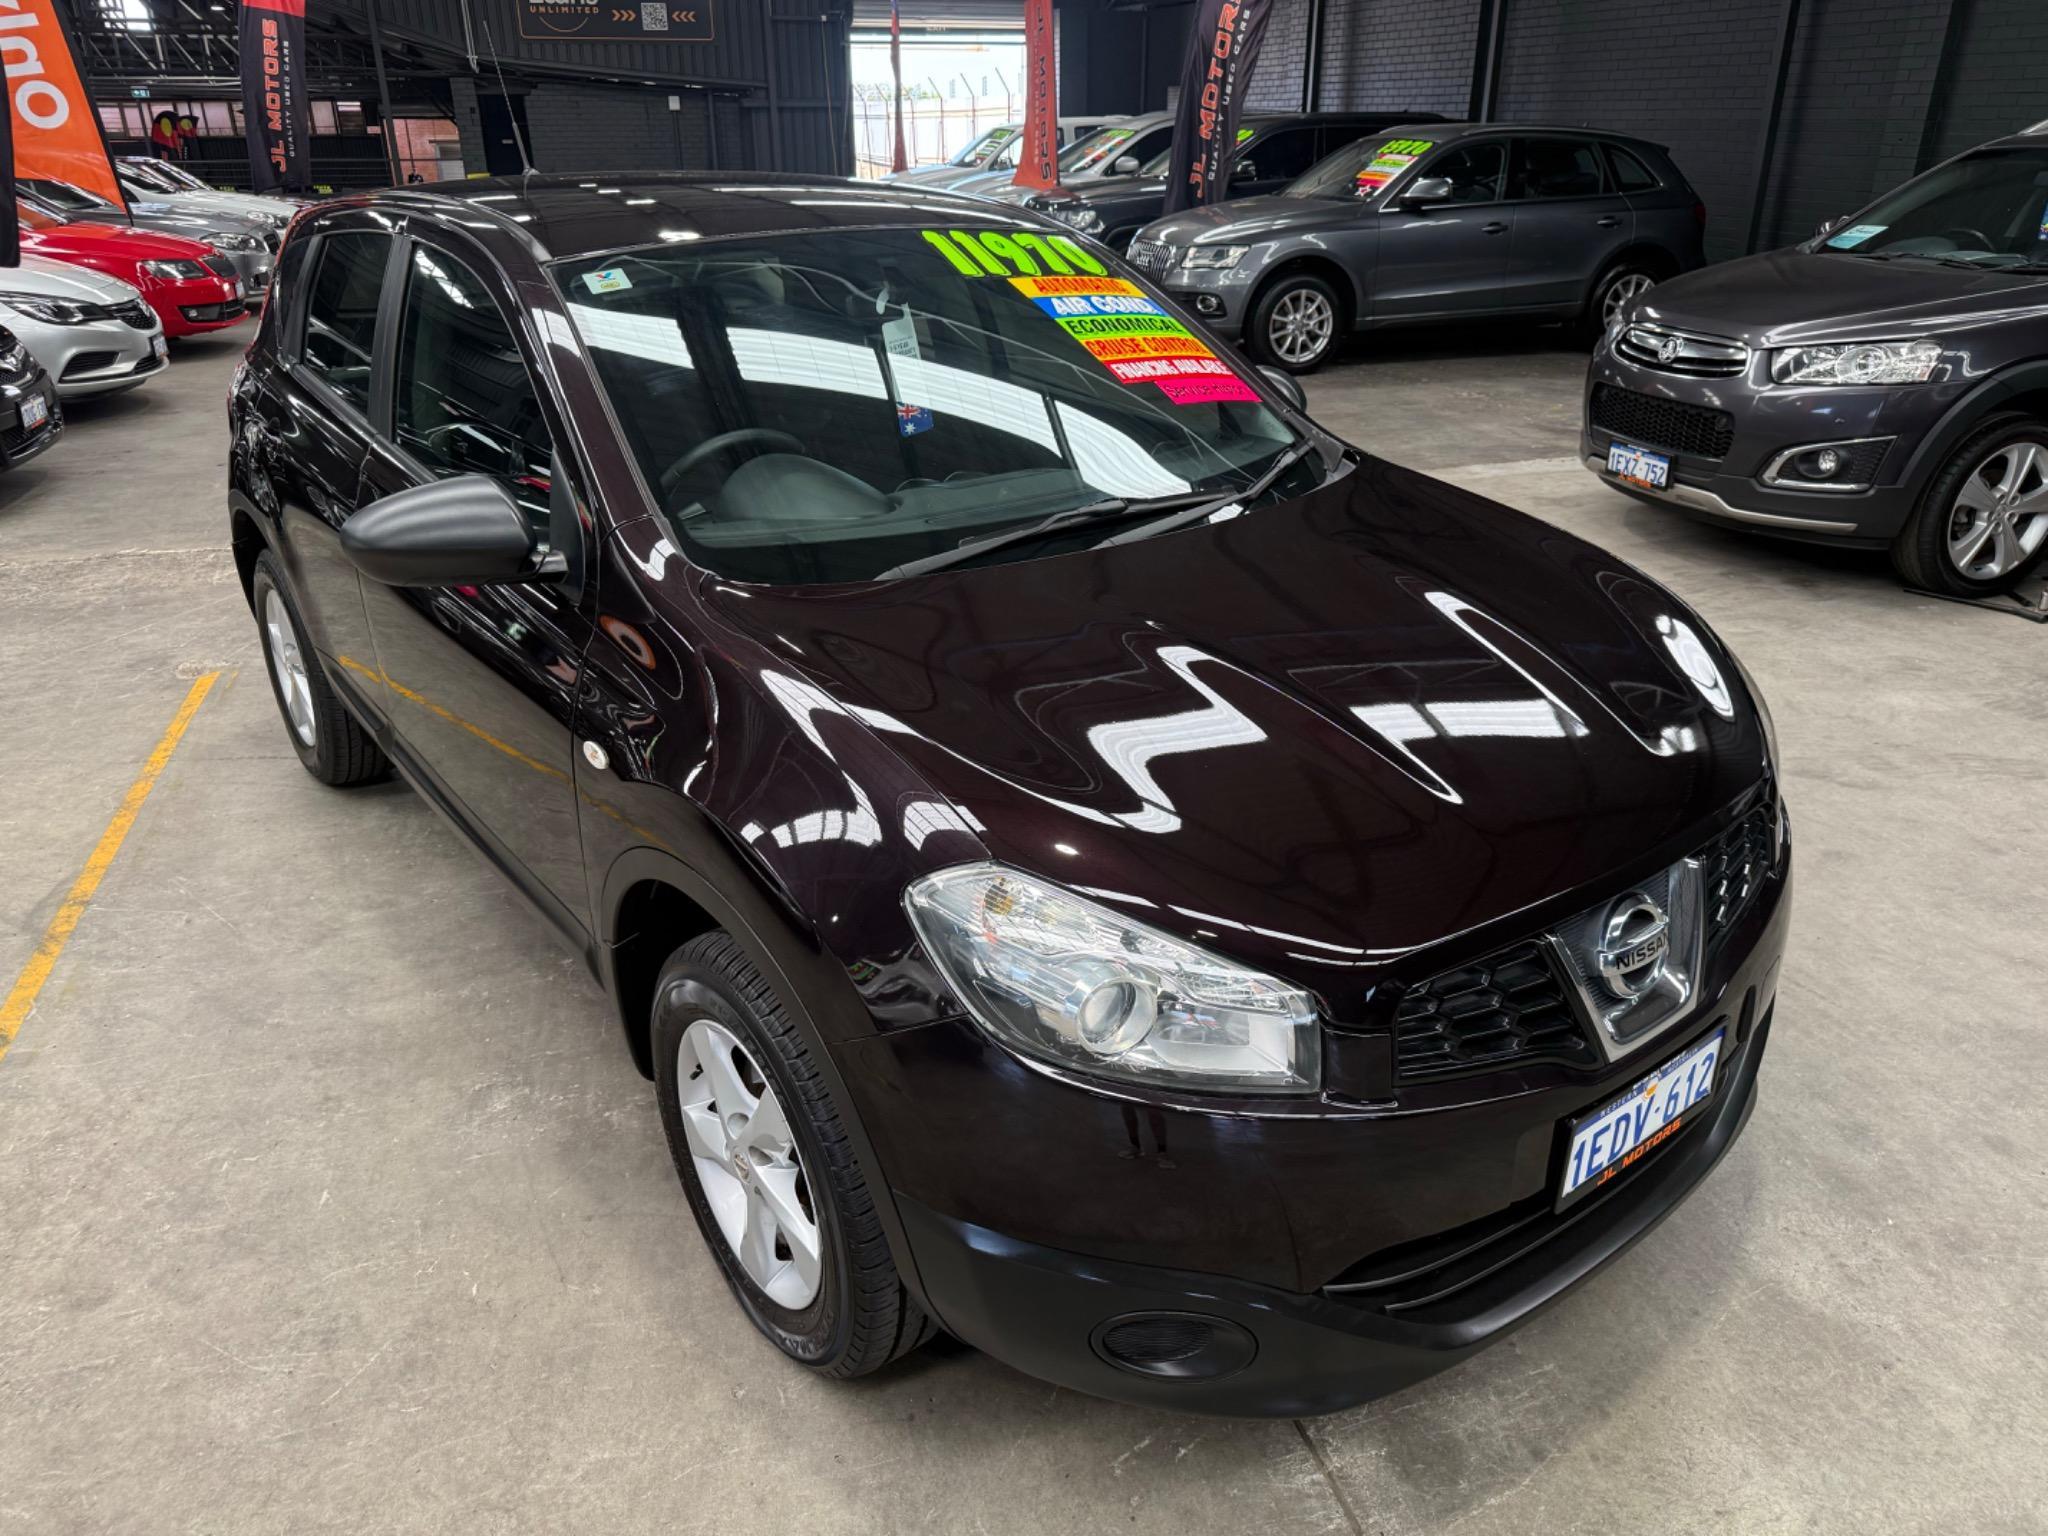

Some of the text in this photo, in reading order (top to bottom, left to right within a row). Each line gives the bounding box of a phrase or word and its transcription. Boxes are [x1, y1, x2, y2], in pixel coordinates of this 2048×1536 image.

[529, 6, 600, 14] UNLIMITED
[1222, 63, 1236, 105] USED
[1233, 9, 1251, 55] CARS
[262, 18, 287, 174] JL MOTORS
[284, 76, 292, 105] USED
[1189, 0, 1241, 199] JL MOTOR
[921, 230, 1108, 277] 11970
[1032, 277, 1131, 294] AUTOMATIC
[1050, 296, 1099, 315] AIR
[1066, 317, 1184, 335] ECONOMICAL
[1085, 336, 1212, 357] CRUISE CONTROL
[1110, 358, 1234, 380] FINANCING AVAILABLE
[1163, 383, 1212, 399] Service
[1615, 931, 1669, 970] NISSAN
[1596, 1116, 1682, 1187] JL MOTORS
